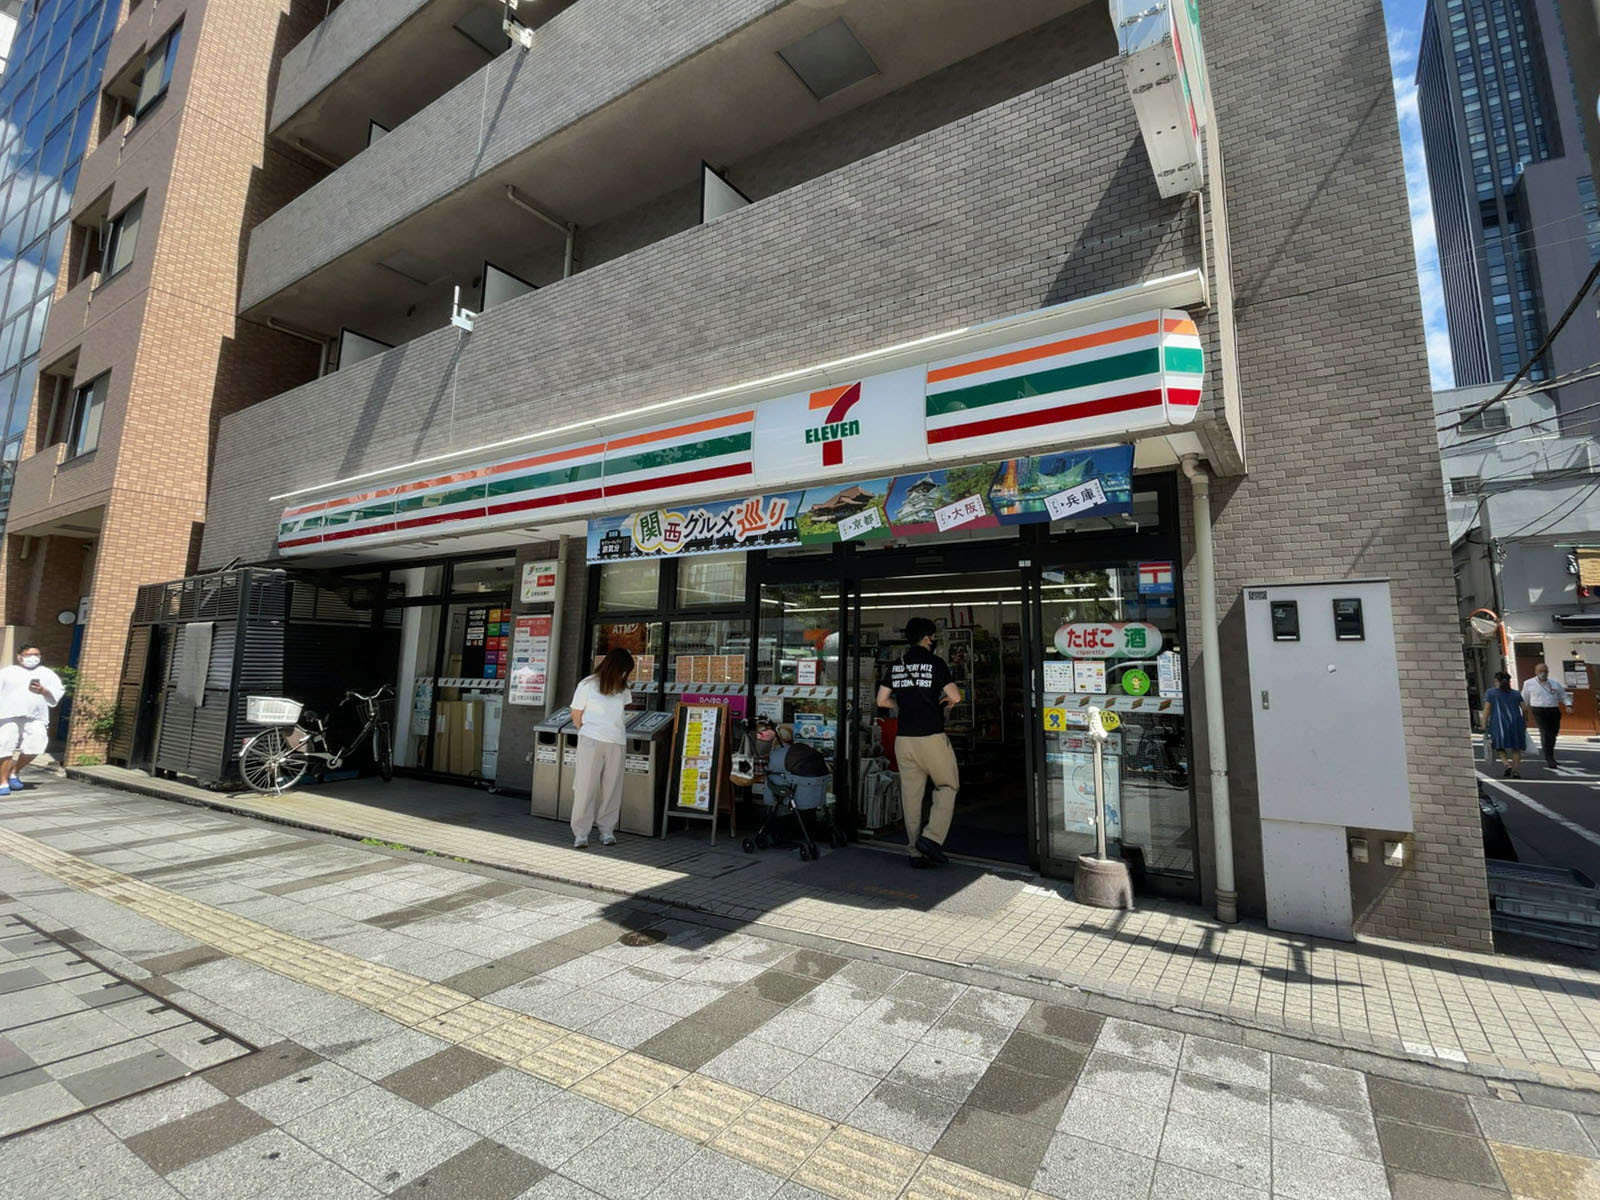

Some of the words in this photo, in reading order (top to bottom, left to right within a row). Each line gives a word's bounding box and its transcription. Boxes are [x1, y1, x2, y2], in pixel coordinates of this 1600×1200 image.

[809, 381, 862, 466] 7
[1066, 488, 1096, 508] 兵庫
[640, 498, 787, 543] 関西グルメ巡り
[952, 502, 978, 520] 大阪
[852, 513, 874, 531] 京都
[1067, 627, 1114, 648] たばこ
[1124, 627, 1147, 648] 酒
